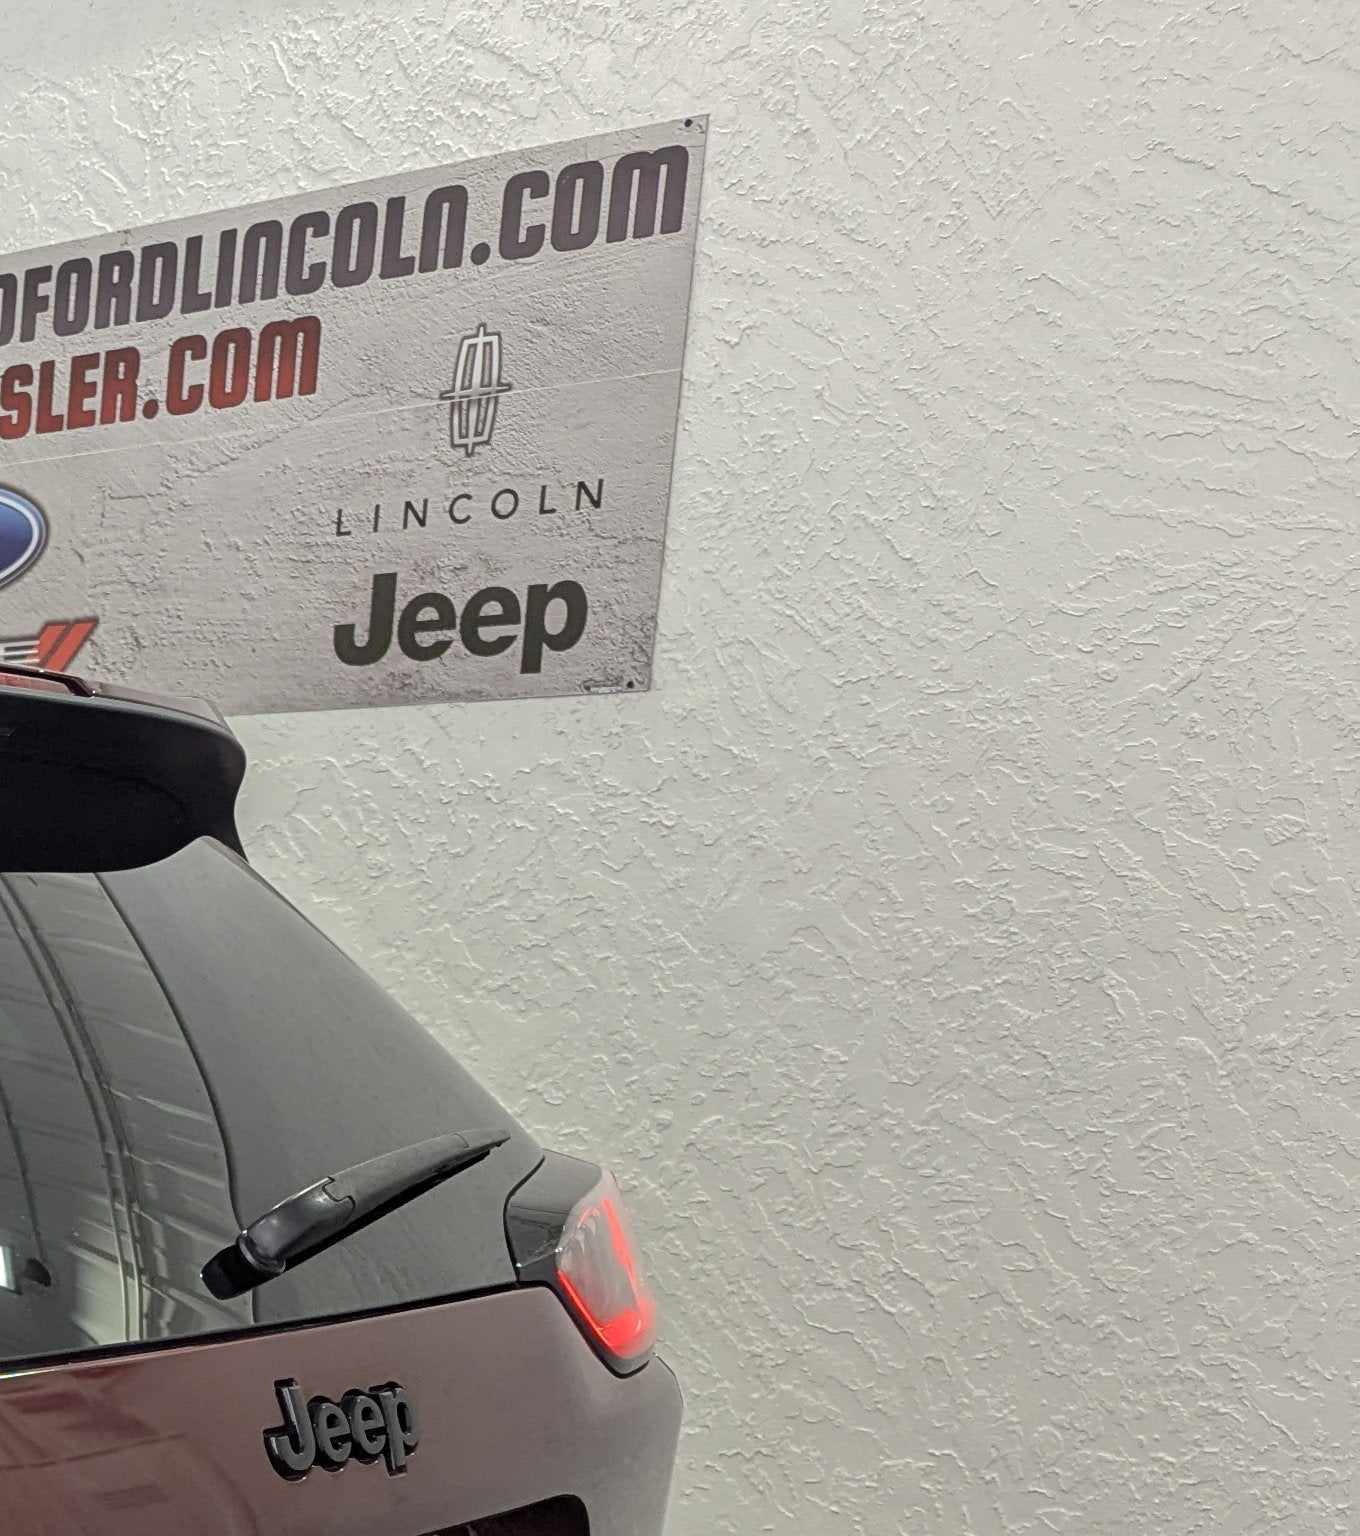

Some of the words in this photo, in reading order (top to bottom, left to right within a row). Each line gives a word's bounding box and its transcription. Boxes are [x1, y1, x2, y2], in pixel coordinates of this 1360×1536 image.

[335, 478, 604, 537] LINCOLN
[333, 572, 588, 675] Jeep
[263, 1378, 420, 1482] Jeep
